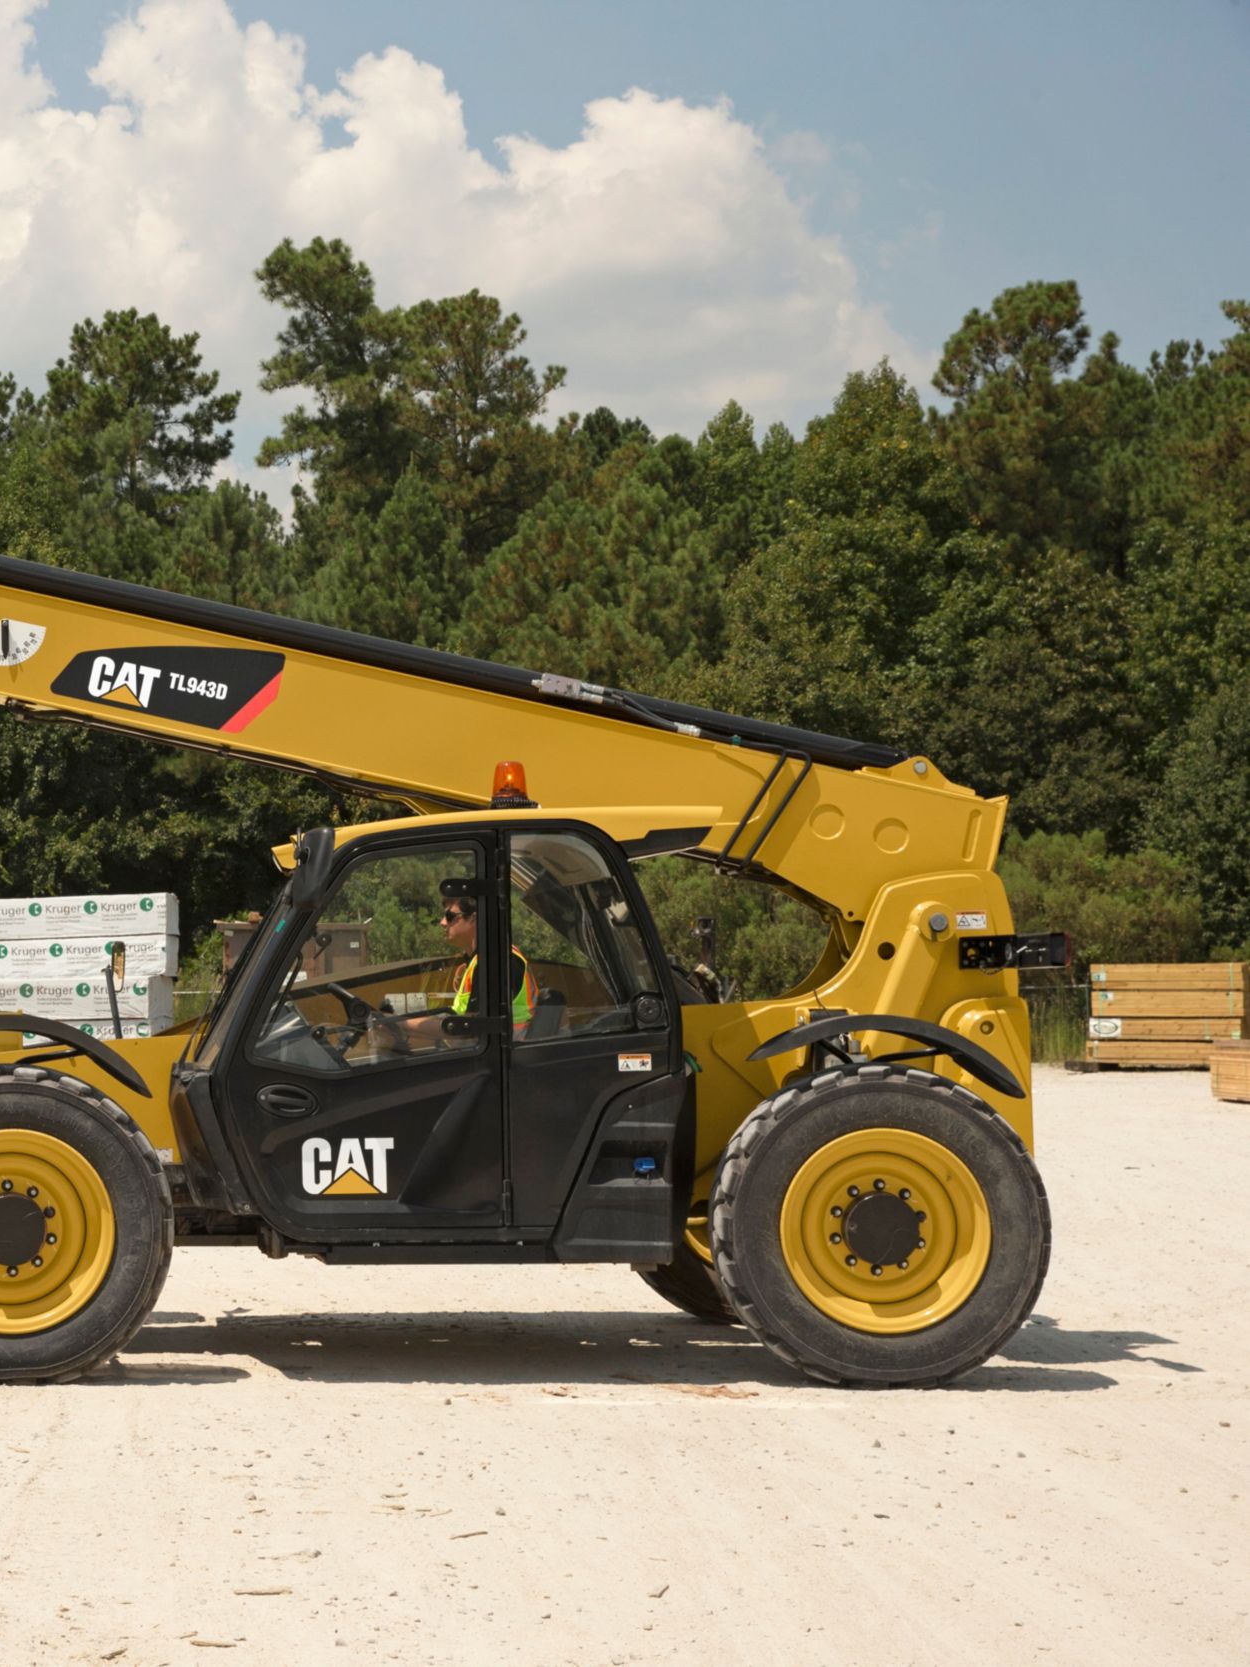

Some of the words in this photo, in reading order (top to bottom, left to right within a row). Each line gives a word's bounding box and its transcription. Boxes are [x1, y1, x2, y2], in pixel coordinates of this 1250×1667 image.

[88, 656, 162, 708] CAT
[169, 672, 228, 700] TL943D
[45, 904, 81, 914] Kruger
[100, 902, 137, 913] Kruger
[11, 946, 47, 957] Kruger
[66, 944, 102, 955] Kruger
[36, 985, 73, 996] Kruger
[302, 1137, 394, 1195] CAT
